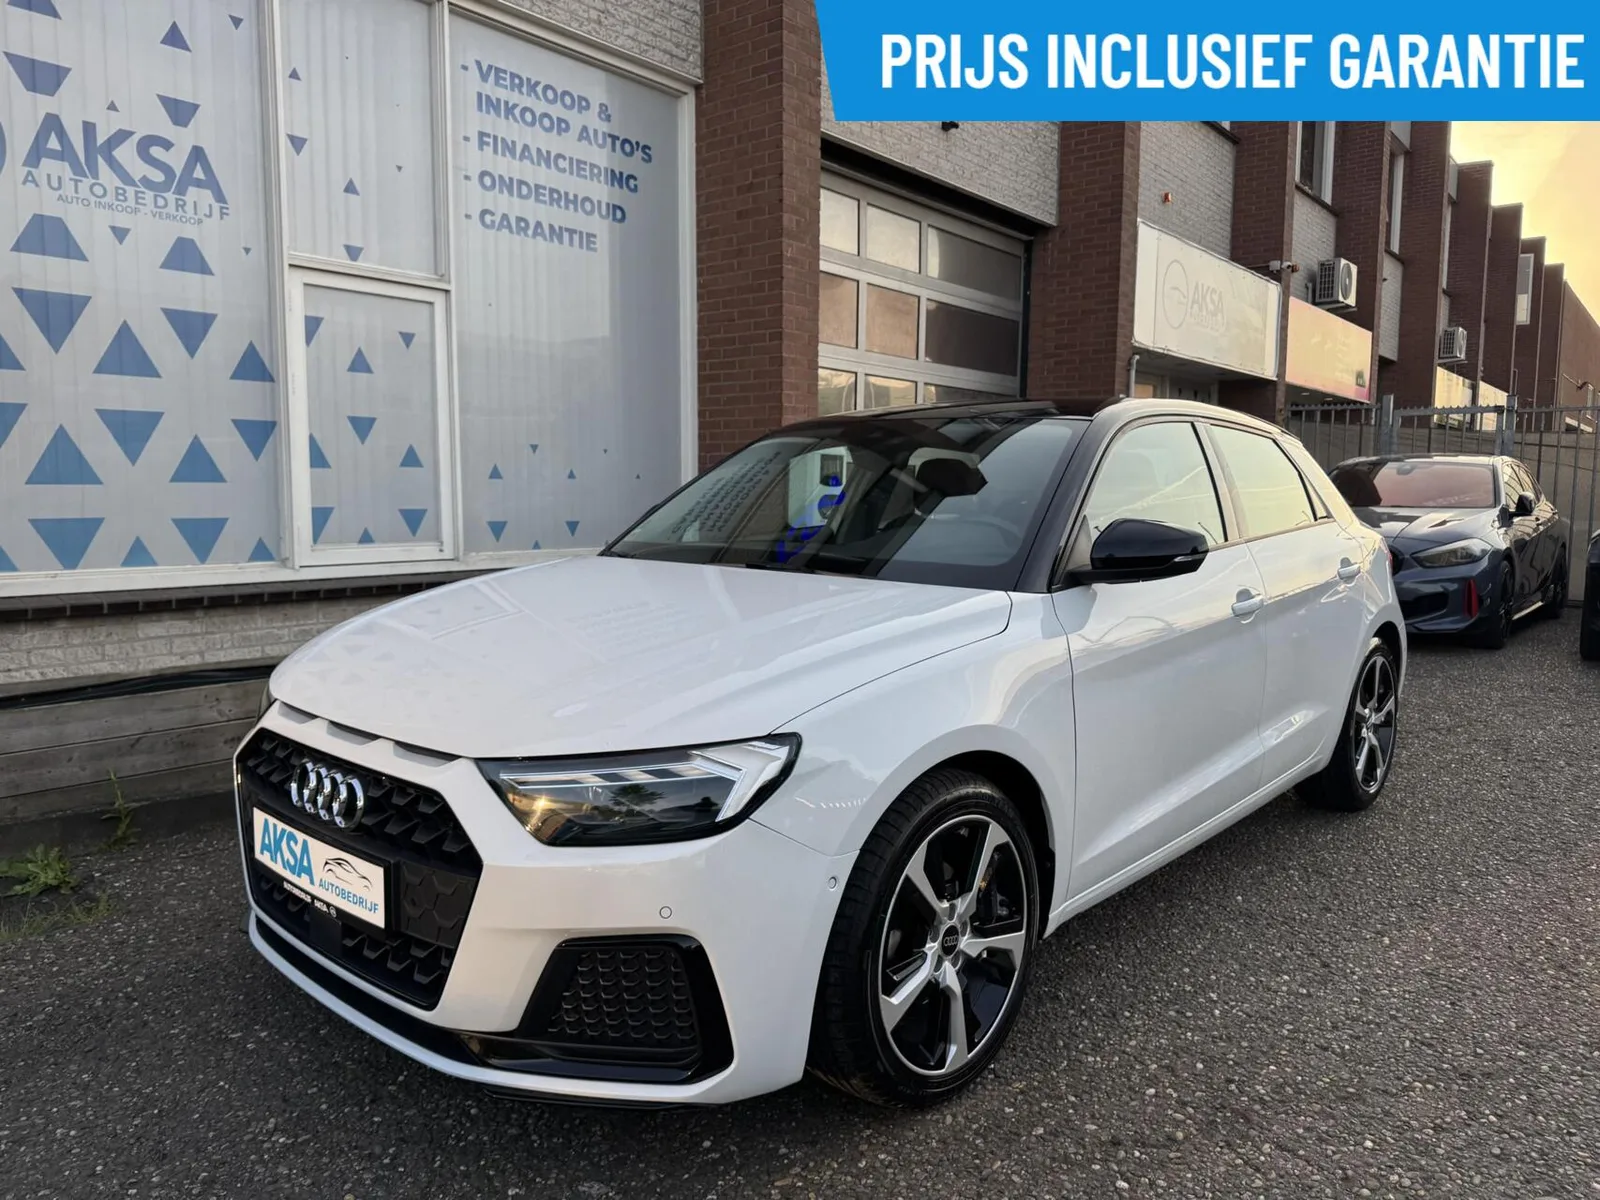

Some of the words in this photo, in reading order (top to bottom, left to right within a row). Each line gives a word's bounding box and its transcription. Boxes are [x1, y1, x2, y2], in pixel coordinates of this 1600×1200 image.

[475, 59, 591, 115] VERKOOP
[597, 102, 612, 123] &
[476, 91, 571, 136] INKOOP
[576, 124, 653, 164] AUTO'S
[21, 112, 229, 205] AKSA
[477, 130, 639, 193] FINANCIERING
[21, 170, 231, 221] AUTOBEDRIJF
[57, 194, 91, 208] AUTO
[94, 200, 141, 216] INKOOP
[150, 210, 204, 226] VERKOOP
[478, 169, 627, 224] ONDERHOUD
[478, 208, 598, 253] GARANTIE
[1189, 281, 1226, 322] AKSA
[259, 817, 316, 887] AKSA
[318, 877, 379, 914] AUTOBEDRIJF
